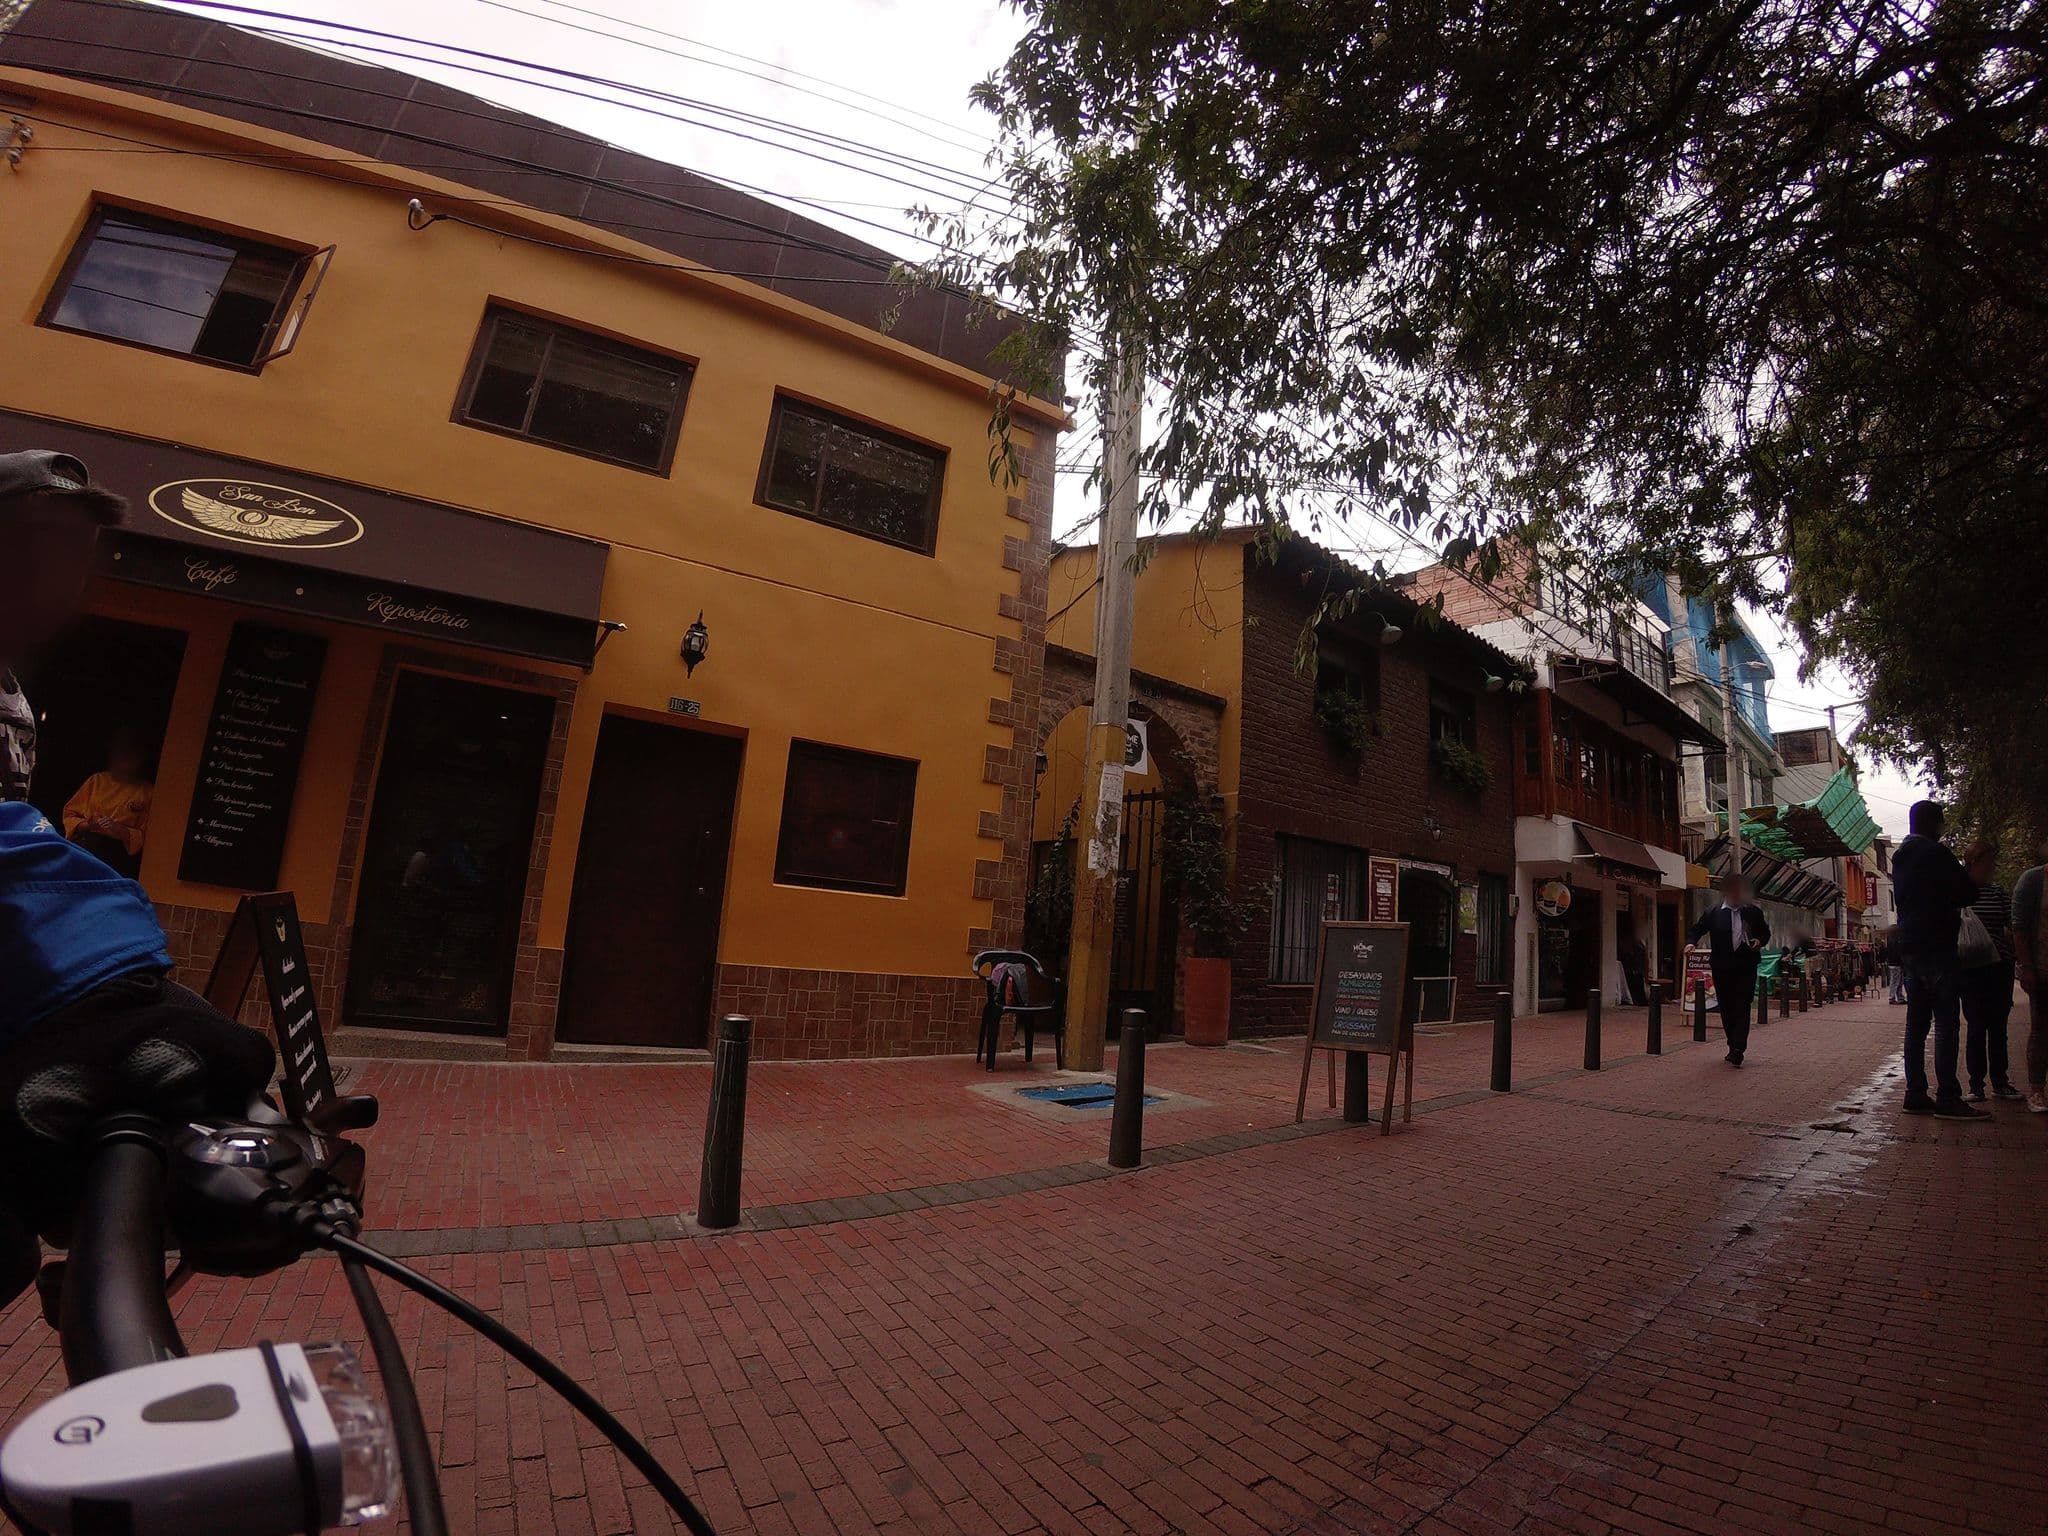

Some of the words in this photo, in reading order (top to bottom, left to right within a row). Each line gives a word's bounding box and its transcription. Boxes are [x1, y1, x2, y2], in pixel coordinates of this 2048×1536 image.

[218, 485, 265, 503] San
[262, 498, 319, 516] Ben
[184, 555, 239, 591] Café
[1338, 971, 1383, 981] DESAYUNOS
